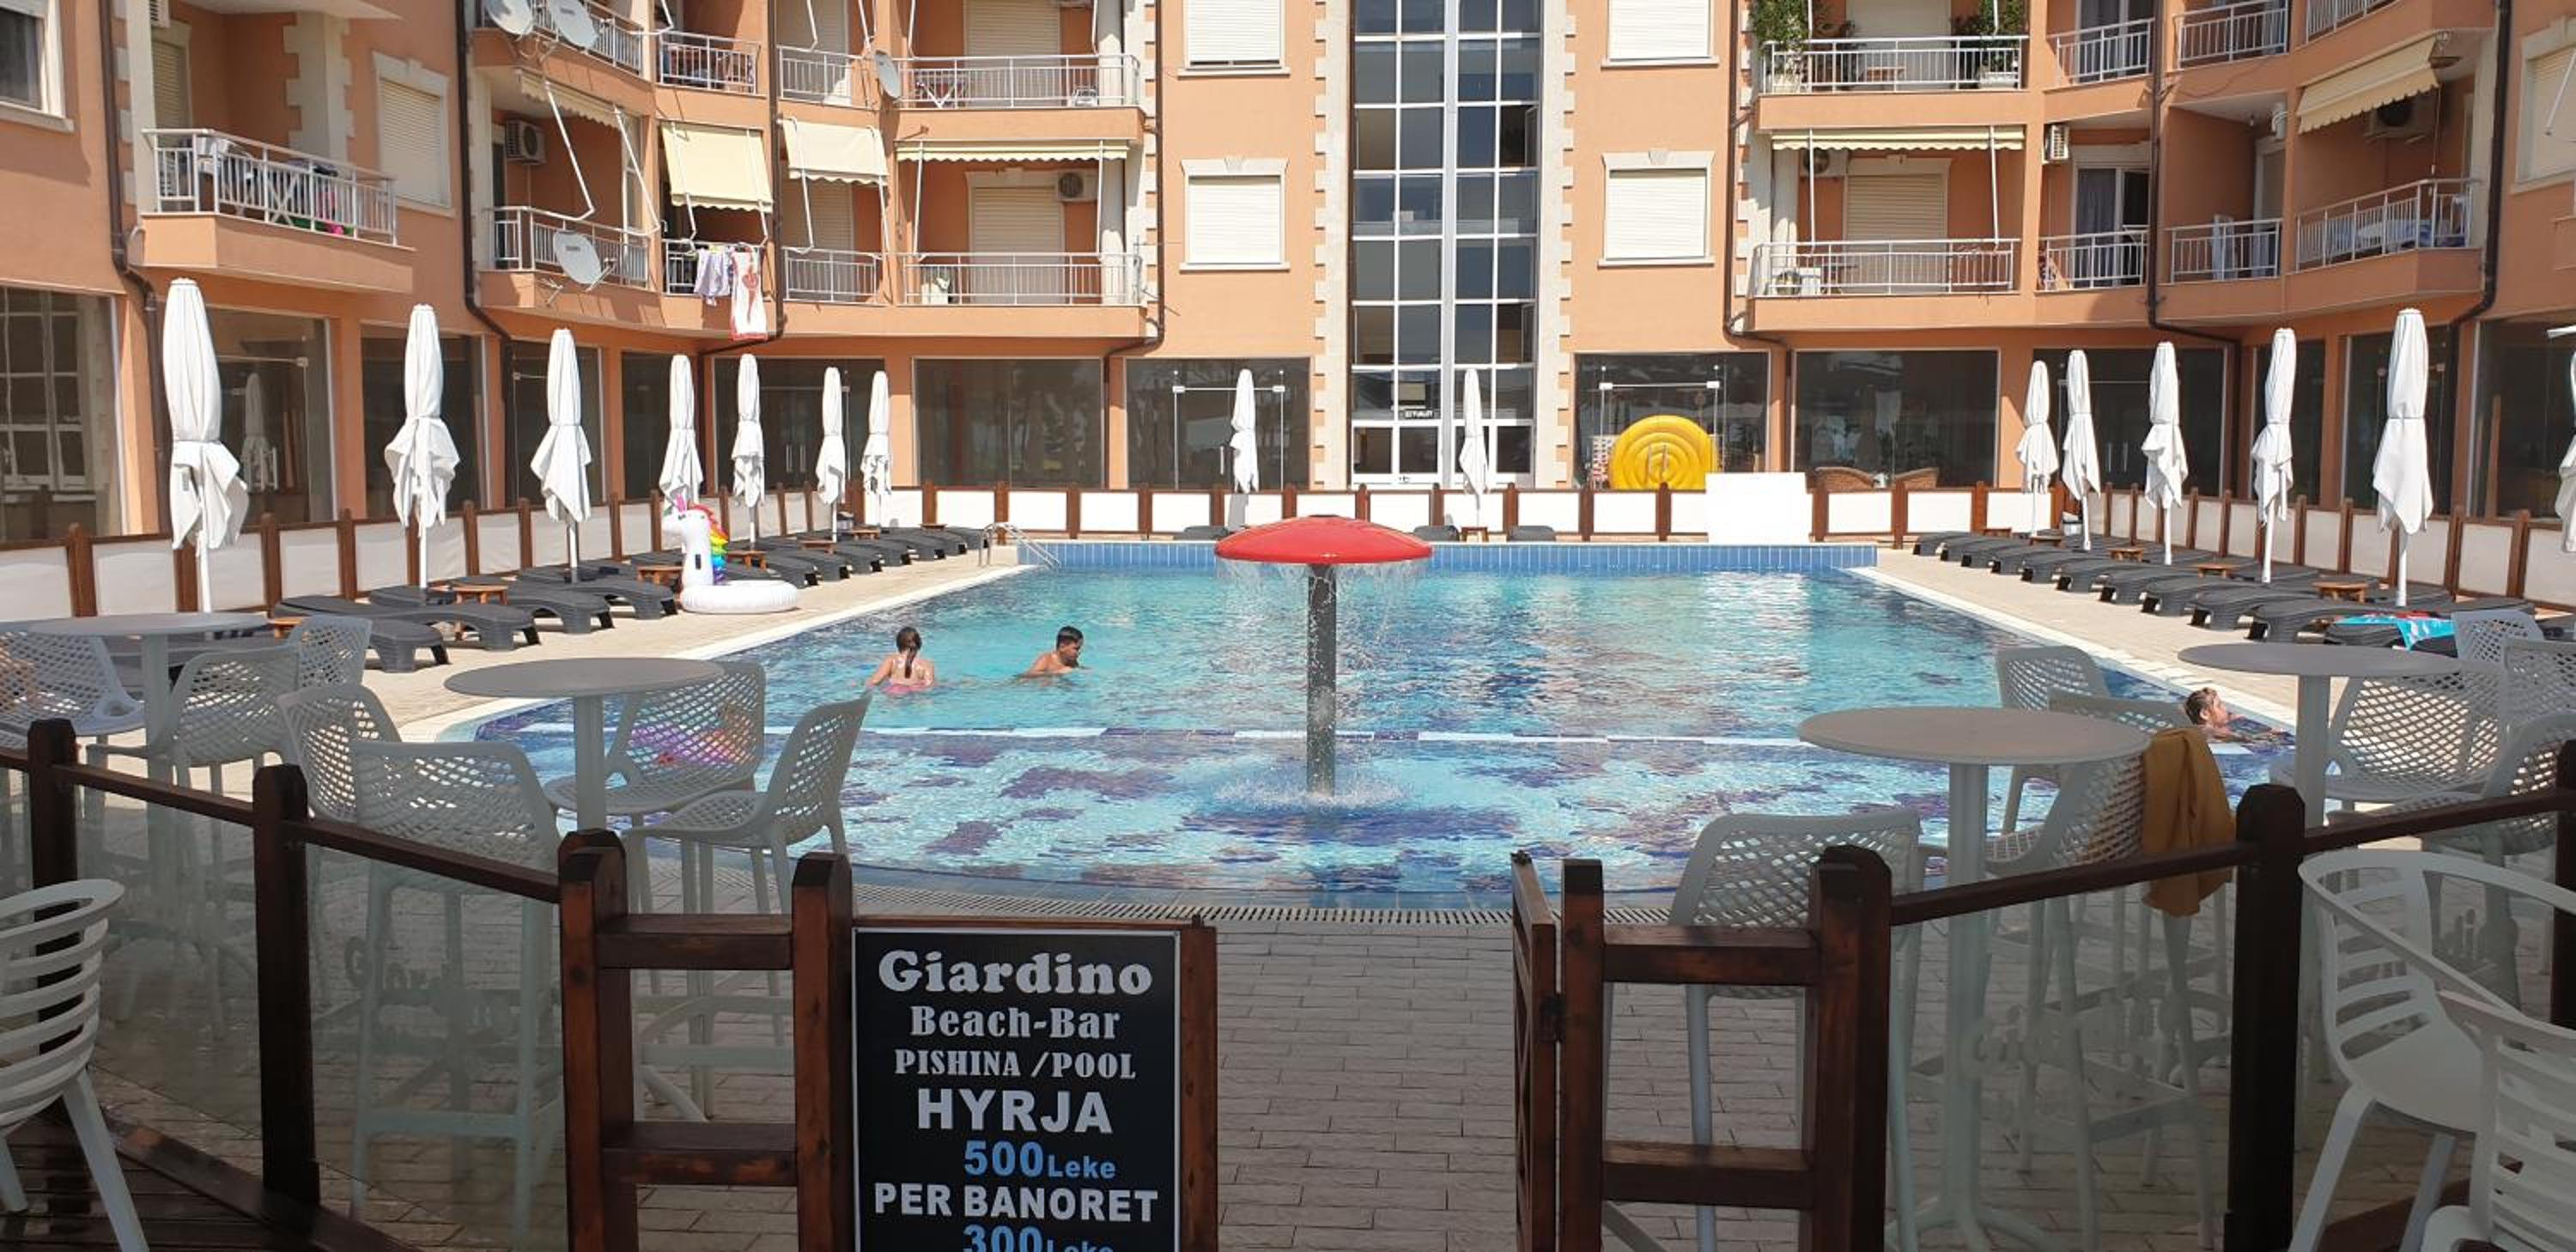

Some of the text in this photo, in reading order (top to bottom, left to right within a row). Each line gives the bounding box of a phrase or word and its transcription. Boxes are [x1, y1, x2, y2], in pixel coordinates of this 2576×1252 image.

[878, 950, 1152, 995] Giardino
[910, 1006, 1121, 1039] Beach-Bar
[895, 1048, 1021, 1077] PISHINA
[918, 1088, 1113, 1133] HYRJA
[875, 1182, 1158, 1222] PER BANORET
